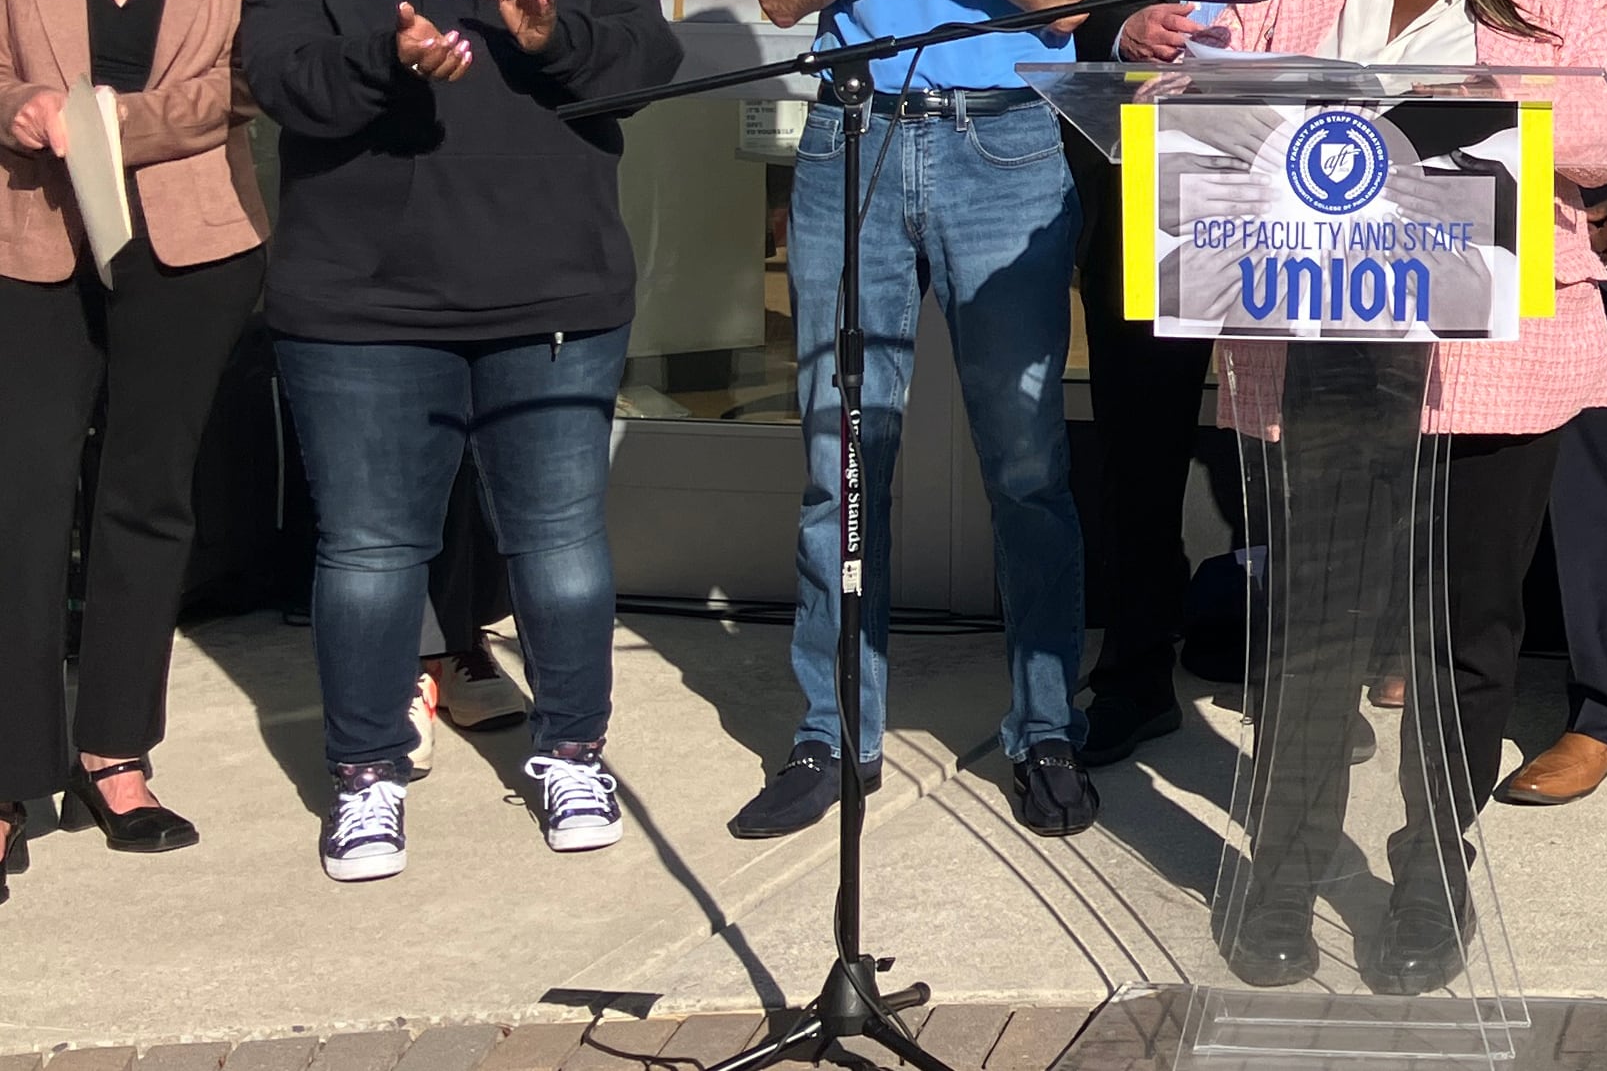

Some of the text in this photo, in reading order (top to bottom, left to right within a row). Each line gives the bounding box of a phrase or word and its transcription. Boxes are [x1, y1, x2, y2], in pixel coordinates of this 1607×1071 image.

[1290, 115, 1384, 161] FACULTY AND STAFF FEDERATION
[1193, 220, 1474, 252] CCP FACULTY AND STAFF
[847, 492, 862, 553] Stands
